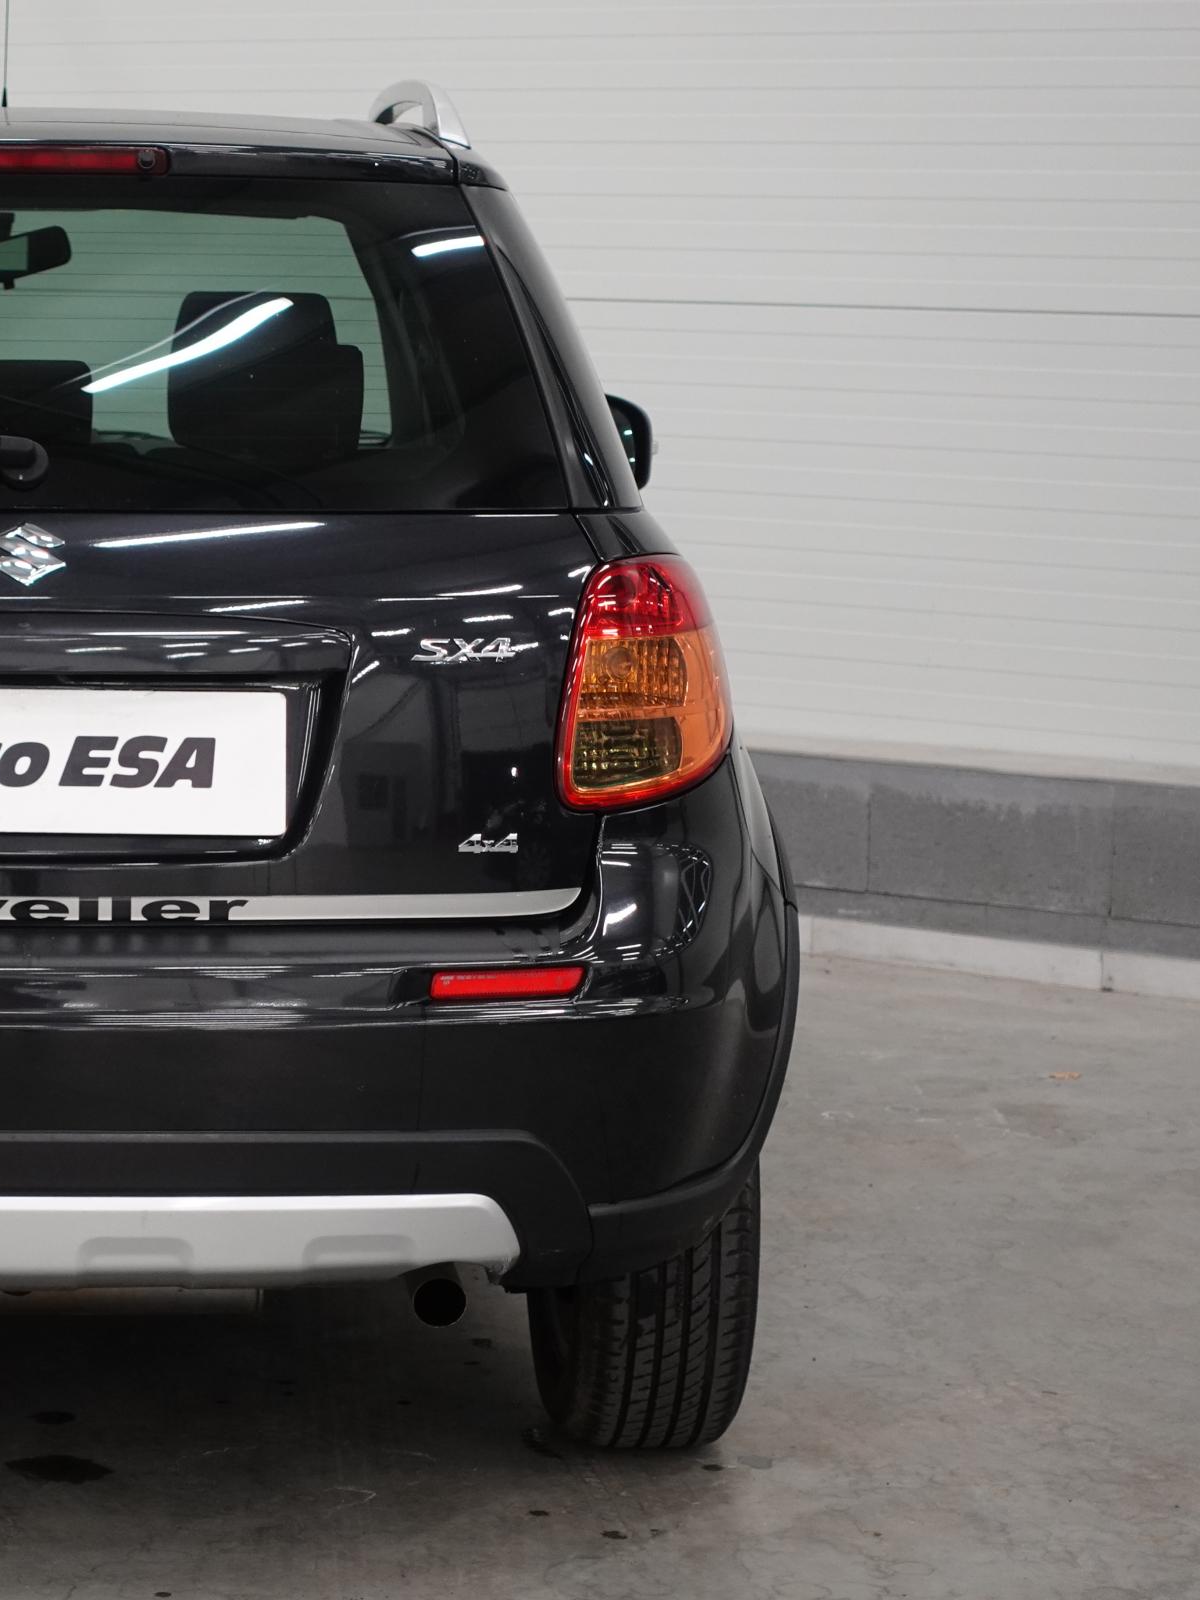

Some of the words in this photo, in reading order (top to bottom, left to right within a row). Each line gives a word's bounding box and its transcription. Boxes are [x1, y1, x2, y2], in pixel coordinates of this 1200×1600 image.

[411, 637, 516, 662] SX4
[58, 734, 217, 789] ESA
[458, 832, 519, 854] 4x4
